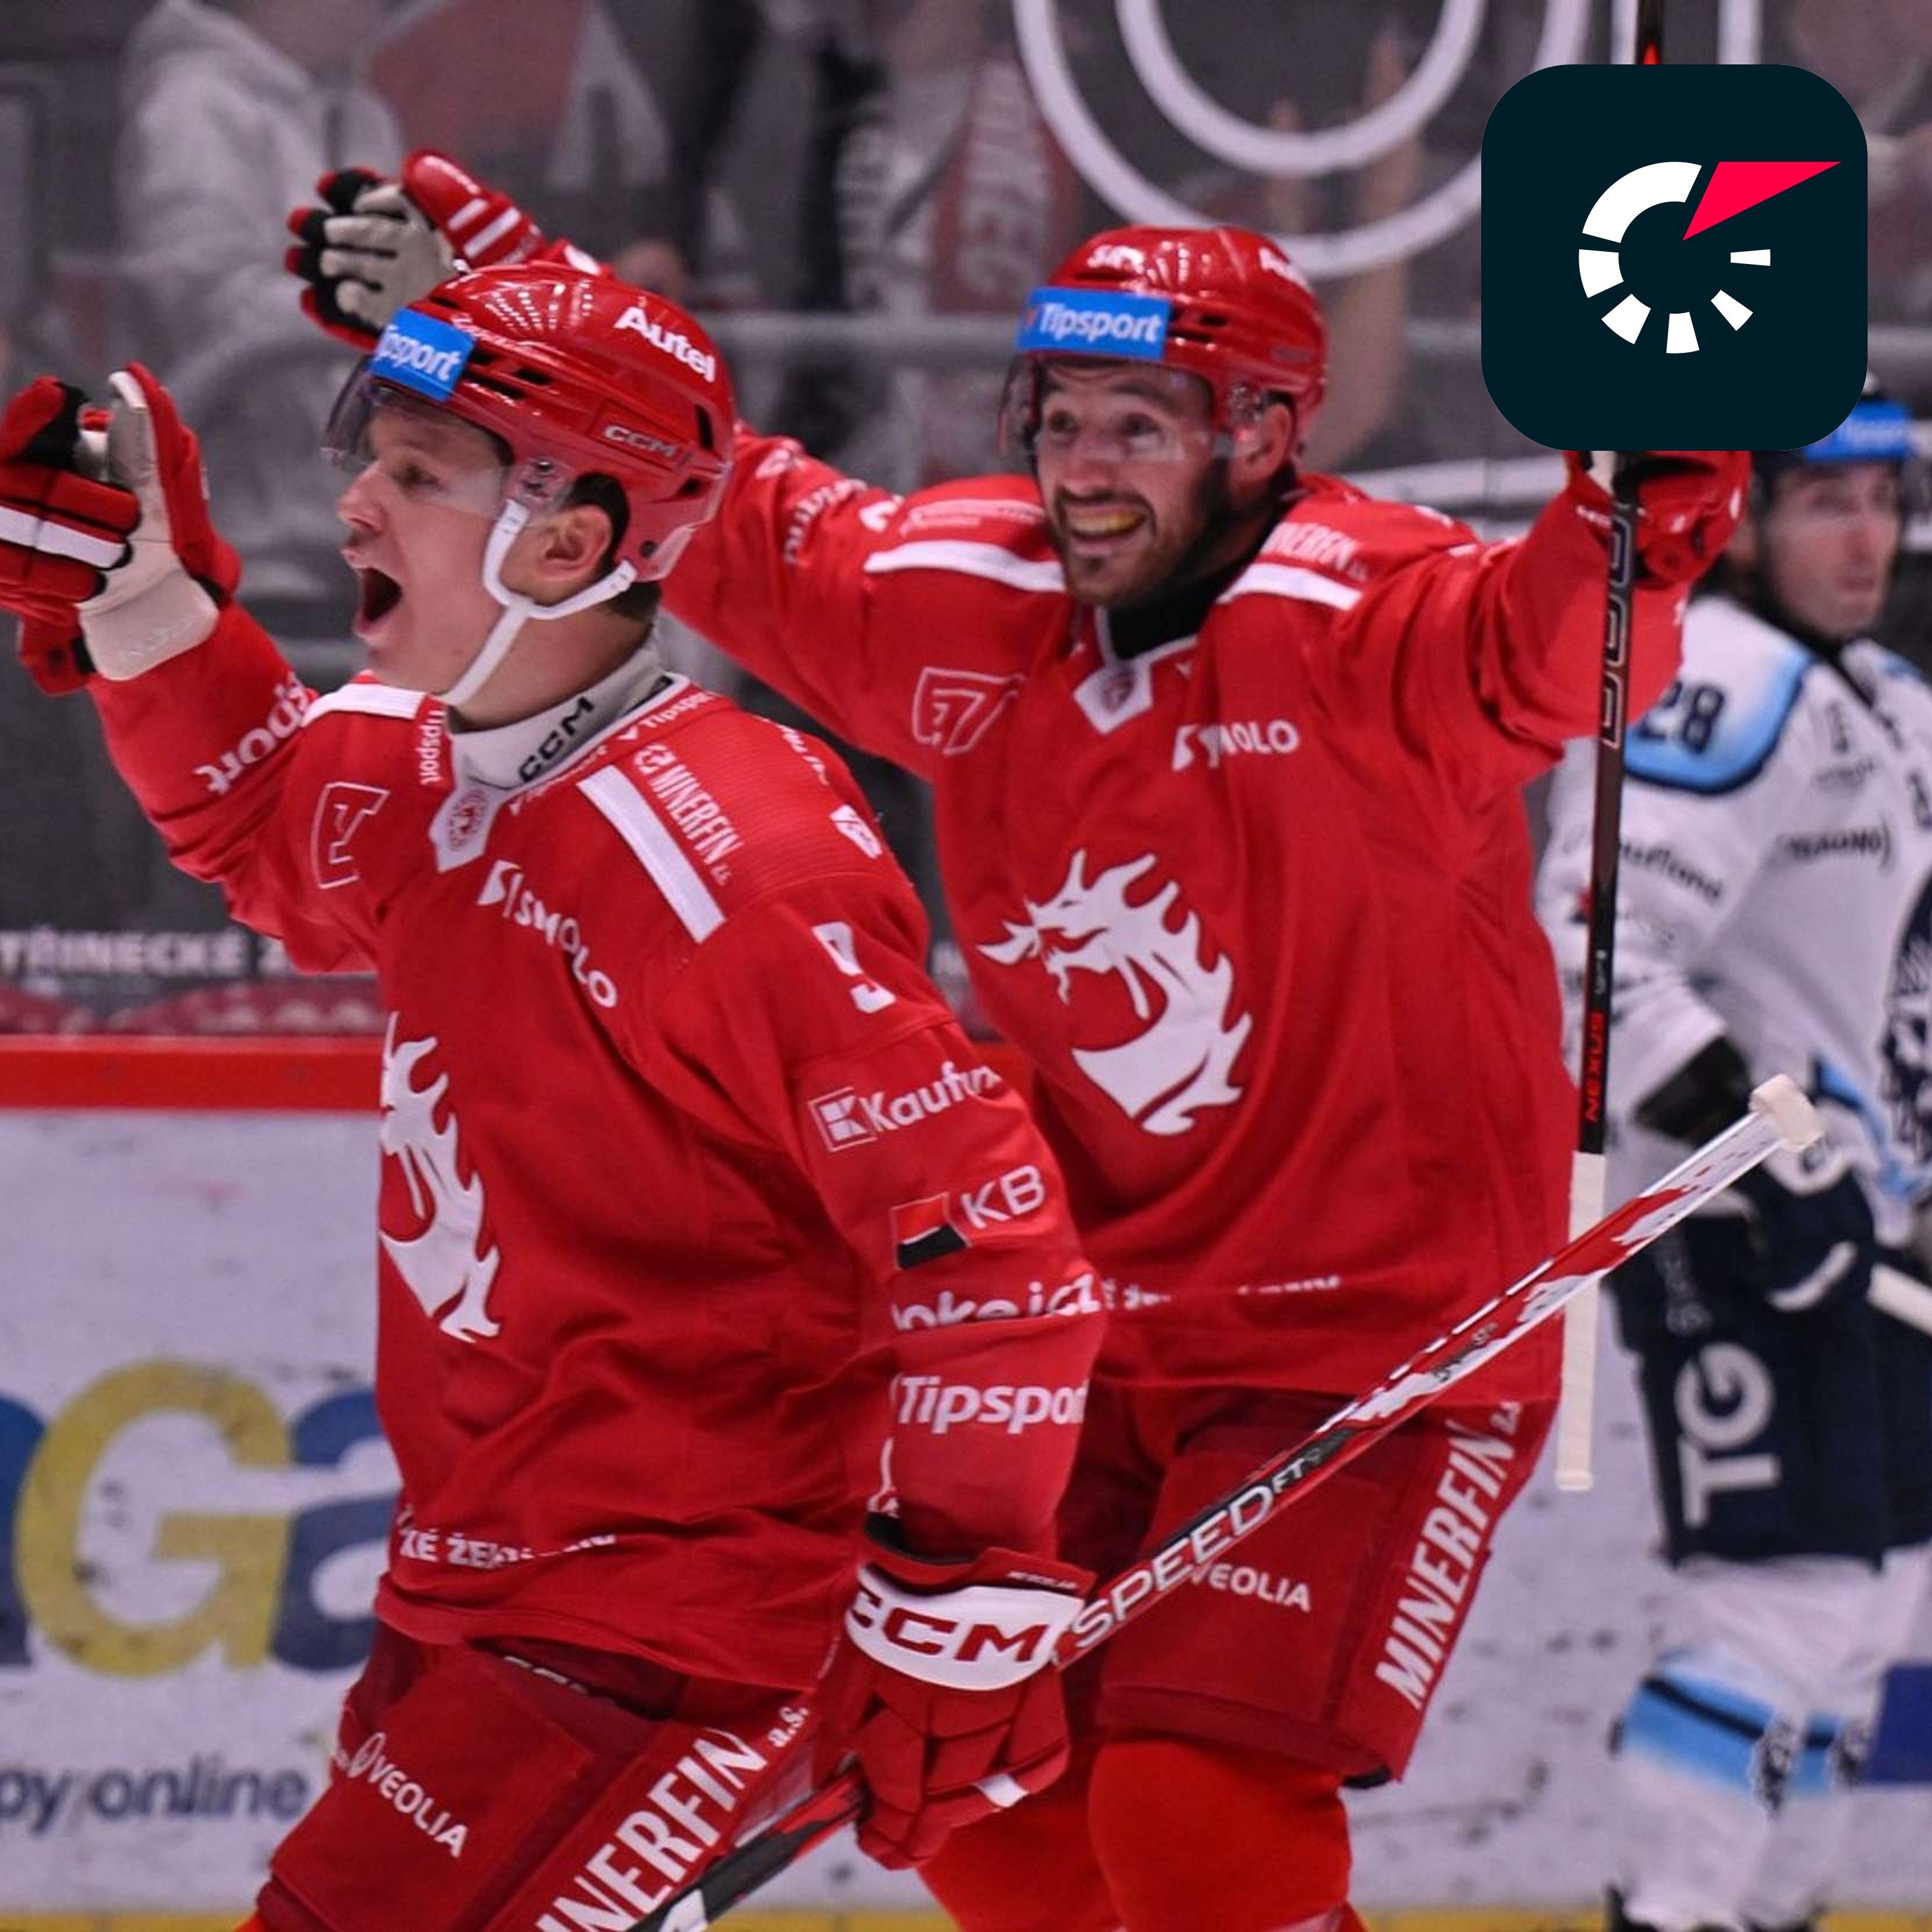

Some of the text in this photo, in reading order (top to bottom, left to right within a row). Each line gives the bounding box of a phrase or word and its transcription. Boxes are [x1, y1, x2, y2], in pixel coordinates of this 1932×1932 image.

[614, 305, 715, 383] Autel
[1039, 302, 1164, 343] Tipsport
[603, 424, 676, 458] CCM
[518, 696, 594, 783] CCM
[649, 764, 744, 865] MINERFIN
[1585, 1011, 1605, 1122] NEXUS
[961, 1165, 1045, 1229] KB
[1675, 1341, 1782, 1530] TG
[1375, 1419, 1515, 1710] MINERFIN
[91, 1753, 310, 1821] online
[366, 1753, 468, 1859] VEOLIA
